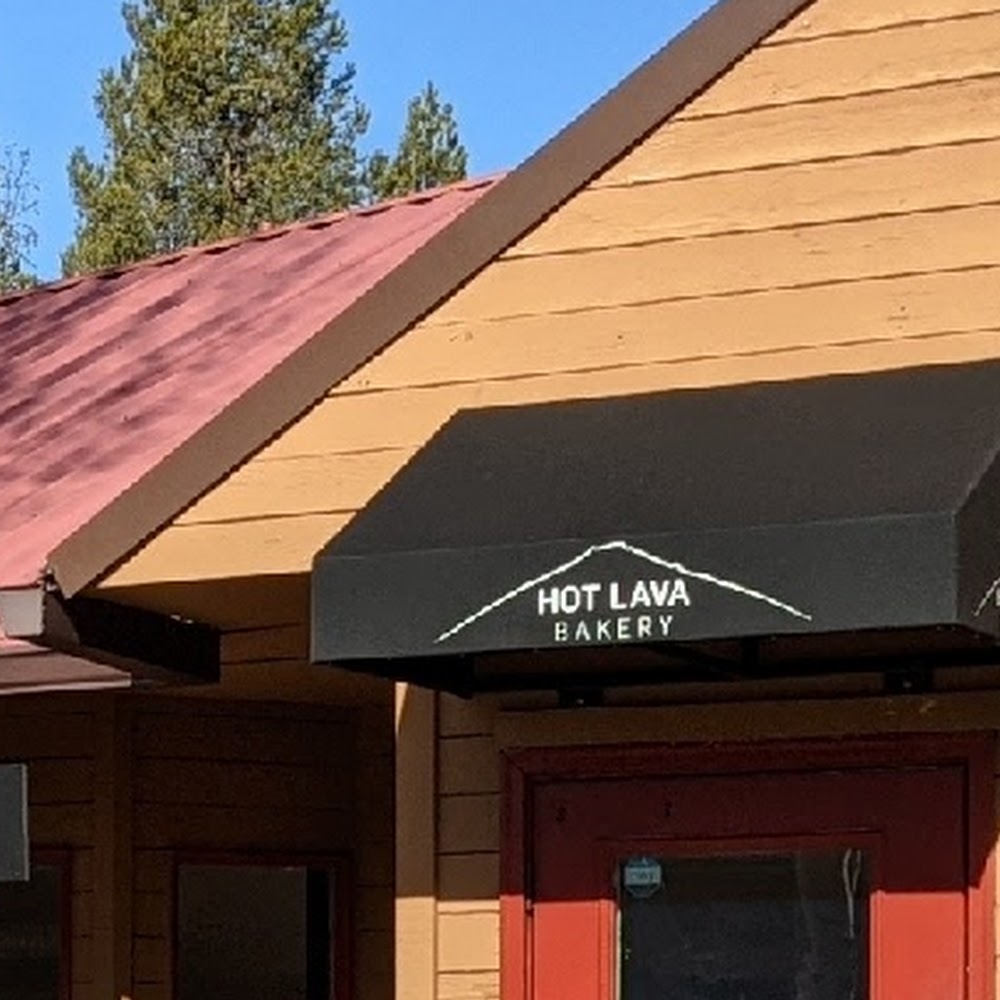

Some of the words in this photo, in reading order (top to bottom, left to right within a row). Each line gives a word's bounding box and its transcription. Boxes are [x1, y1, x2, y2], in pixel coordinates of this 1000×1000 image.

[537, 583, 601, 616] HOT
[609, 578, 691, 611] LAVA
[554, 615, 674, 642] BAKERY
